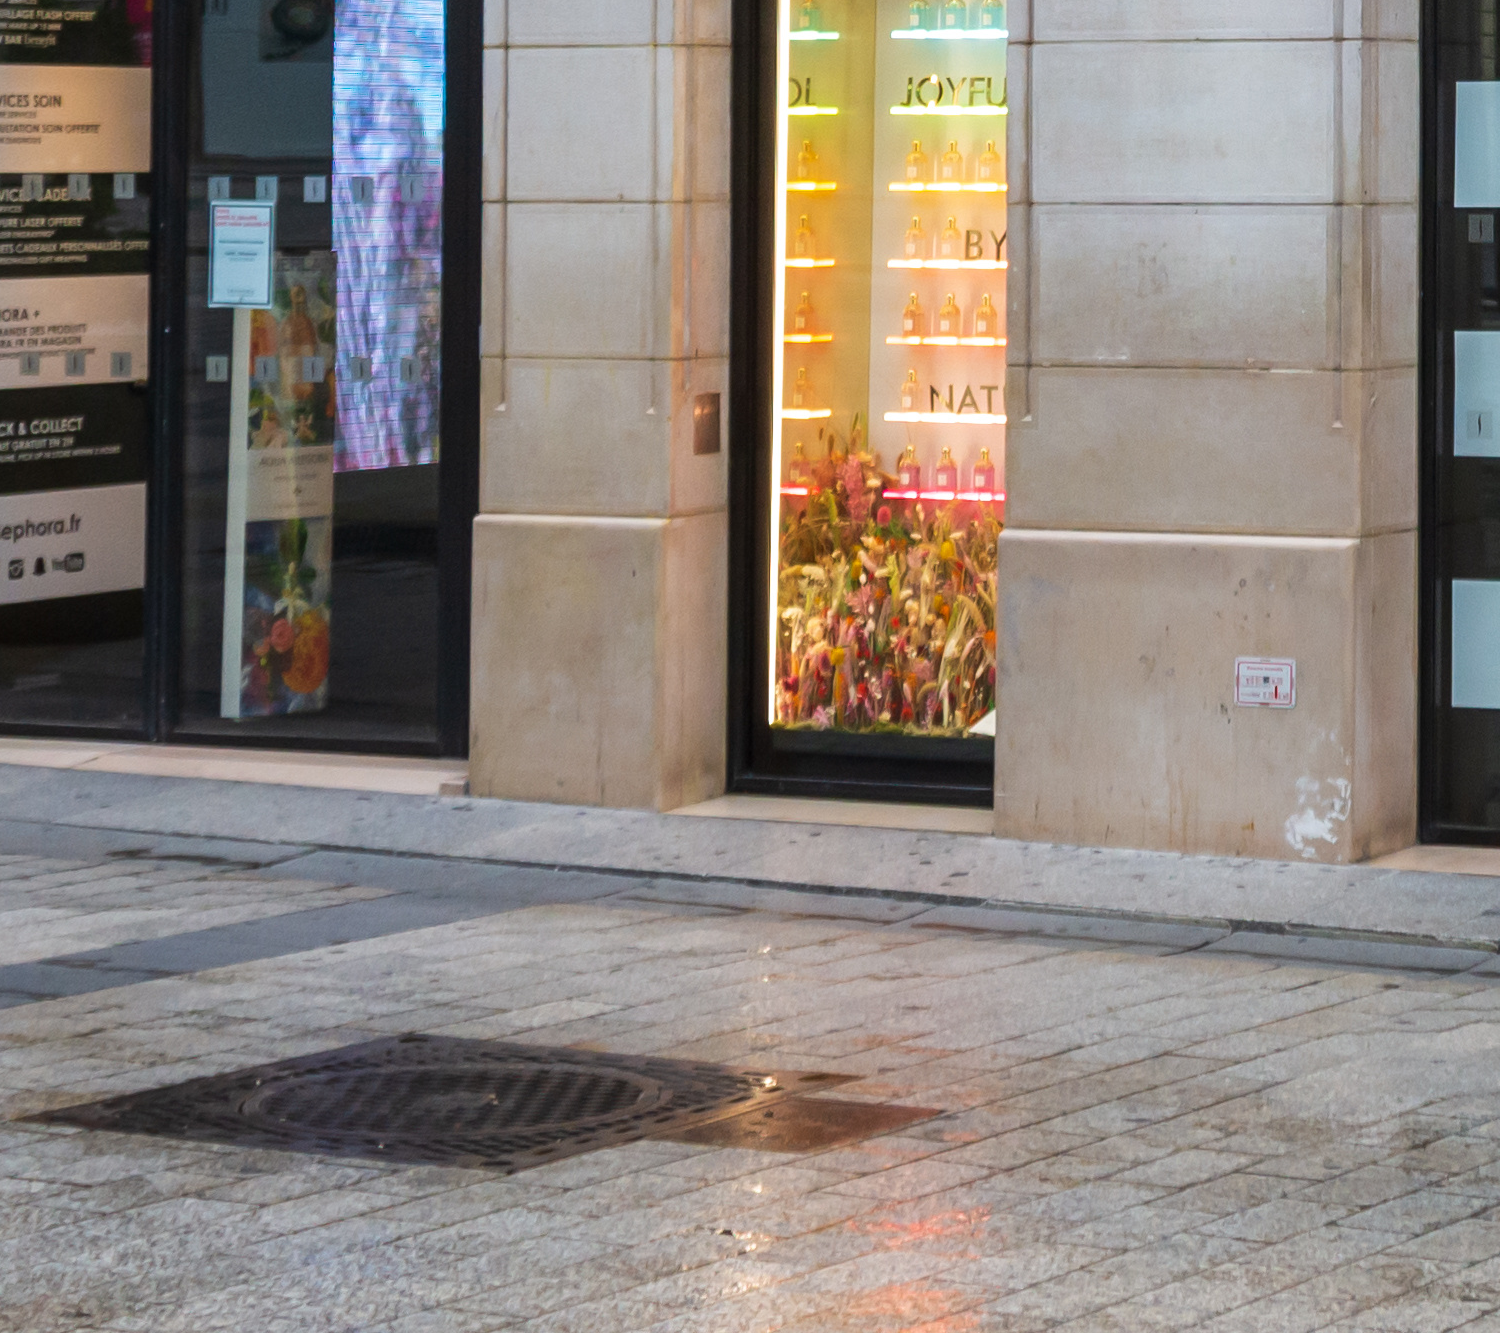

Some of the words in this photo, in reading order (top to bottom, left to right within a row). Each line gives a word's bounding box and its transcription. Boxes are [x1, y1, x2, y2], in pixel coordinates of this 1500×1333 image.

[33, 95, 62, 108] SOIN
[899, 76, 1008, 107] JOYFU
[964, 229, 1007, 260] BY
[33, 310, 40, 319] +
[929, 384, 1007, 414] NAT
[17, 421, 28, 435] &
[29, 416, 84, 434] COLLECT
